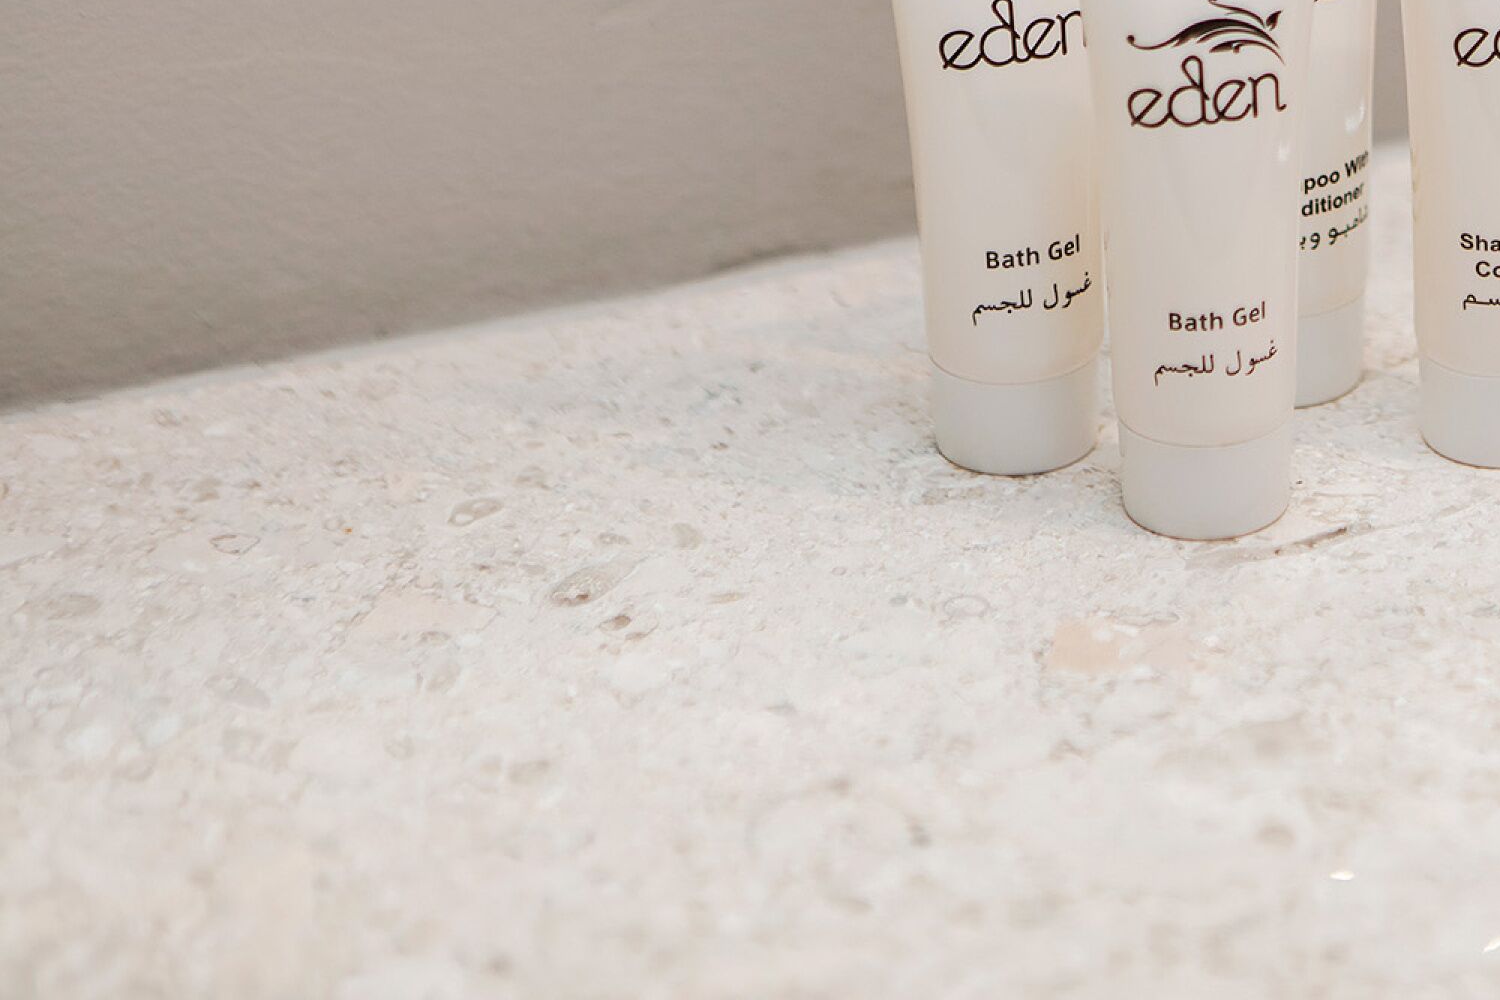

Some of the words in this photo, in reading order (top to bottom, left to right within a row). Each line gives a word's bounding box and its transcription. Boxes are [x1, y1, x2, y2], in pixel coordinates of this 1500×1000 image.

[1127, 55, 1287, 129] eden
[1301, 182, 1365, 217] ditioner
[985, 247, 1040, 269] Bath
[1048, 233, 1080, 260] Gel
[972, 288, 1032, 326] للجسم
[1043, 271, 1092, 310] غسول
[1168, 312, 1224, 332] Bath
[1232, 300, 1266, 327] Gel
[1154, 353, 1214, 387] للجسم
[1225, 339, 1278, 376] غسول
